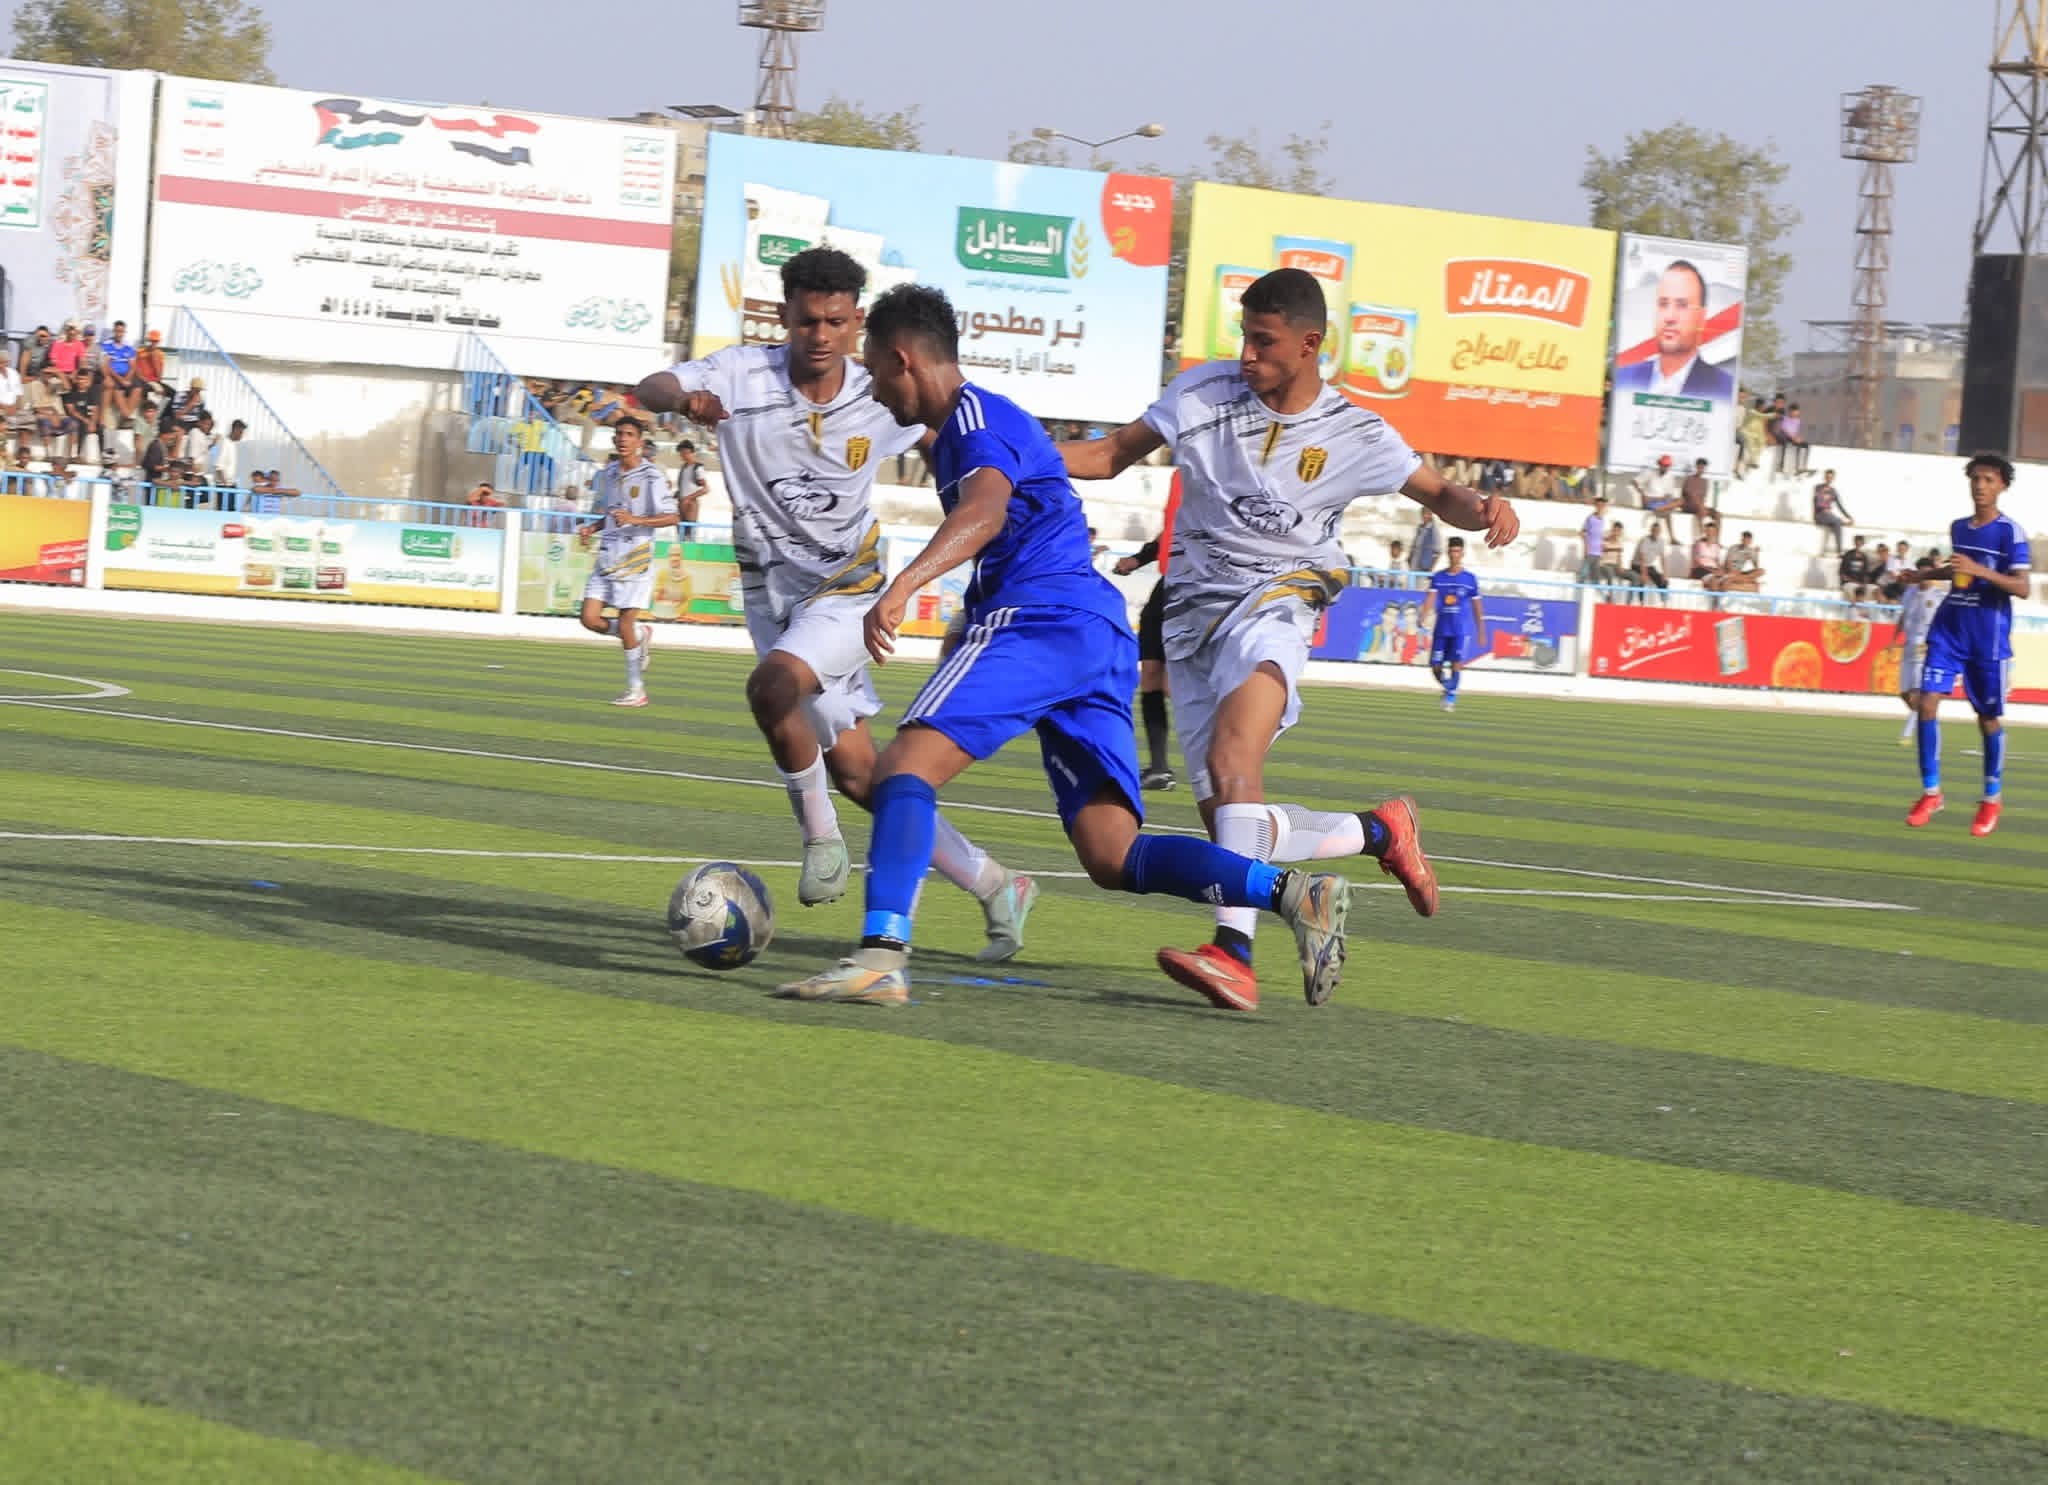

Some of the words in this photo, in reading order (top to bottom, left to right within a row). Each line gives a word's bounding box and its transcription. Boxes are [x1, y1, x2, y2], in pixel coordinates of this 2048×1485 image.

[1112, 192, 1156, 213] جديد
[965, 218, 1064, 260] السنابل
[1459, 269, 1575, 313] الممتاز
